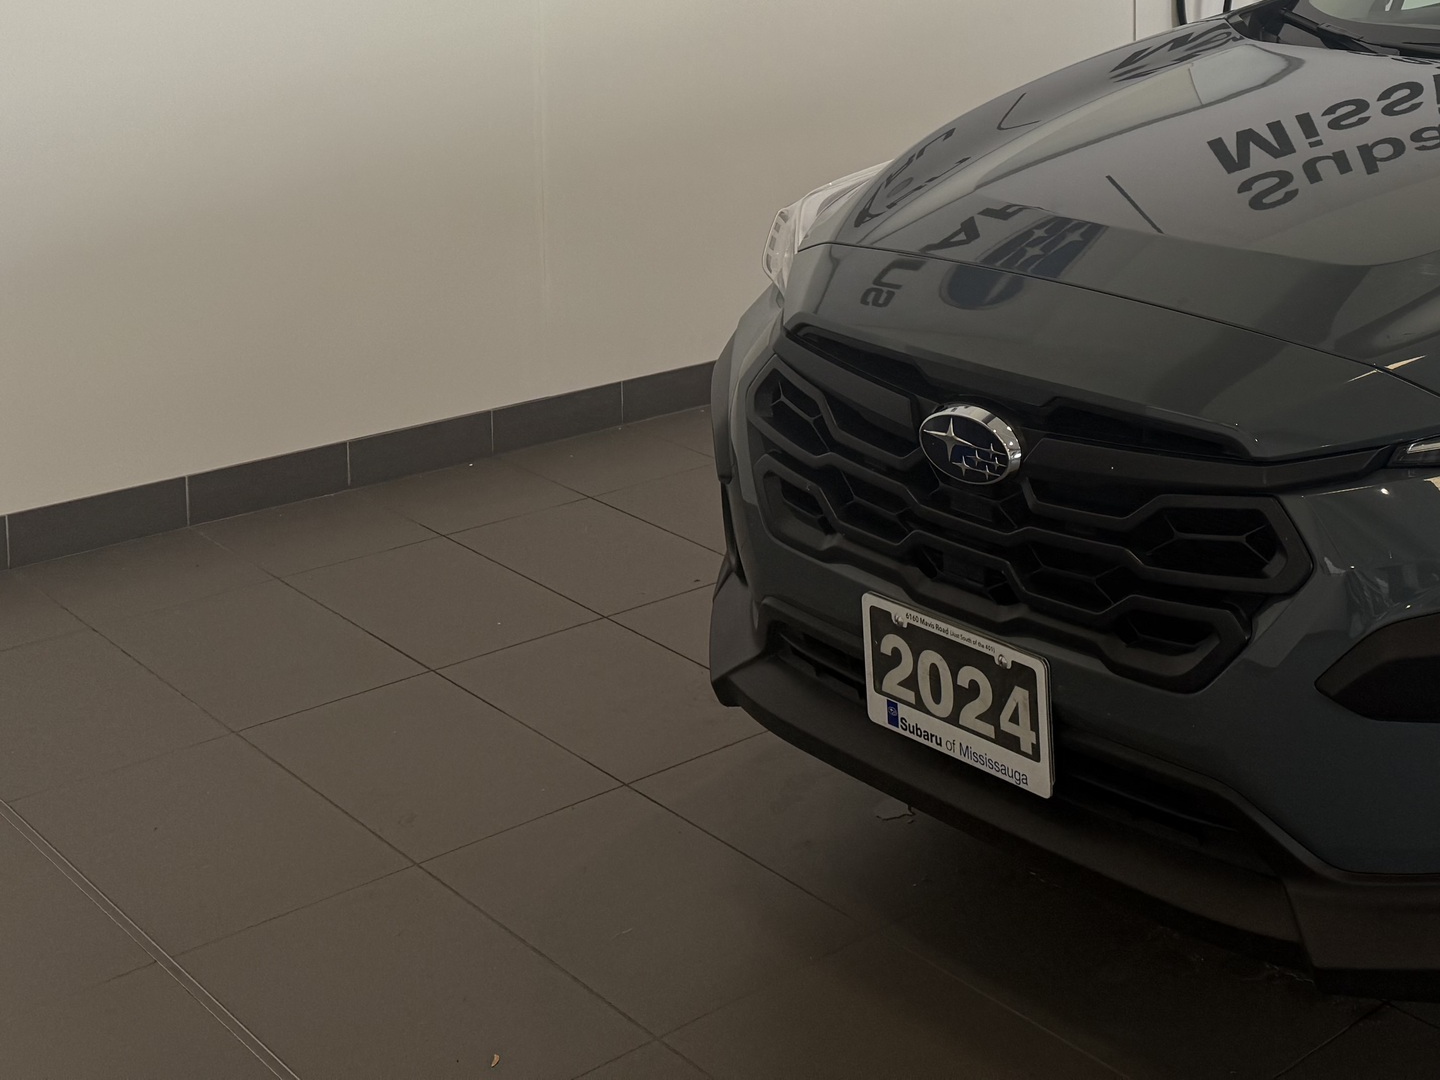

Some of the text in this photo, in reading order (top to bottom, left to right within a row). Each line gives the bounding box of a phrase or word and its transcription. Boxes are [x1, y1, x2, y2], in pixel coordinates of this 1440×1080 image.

[935, 623, 949, 635] Road
[880, 633, 1037, 755] 2024
[900, 716, 1029, 786] Subaru of Mississauga
